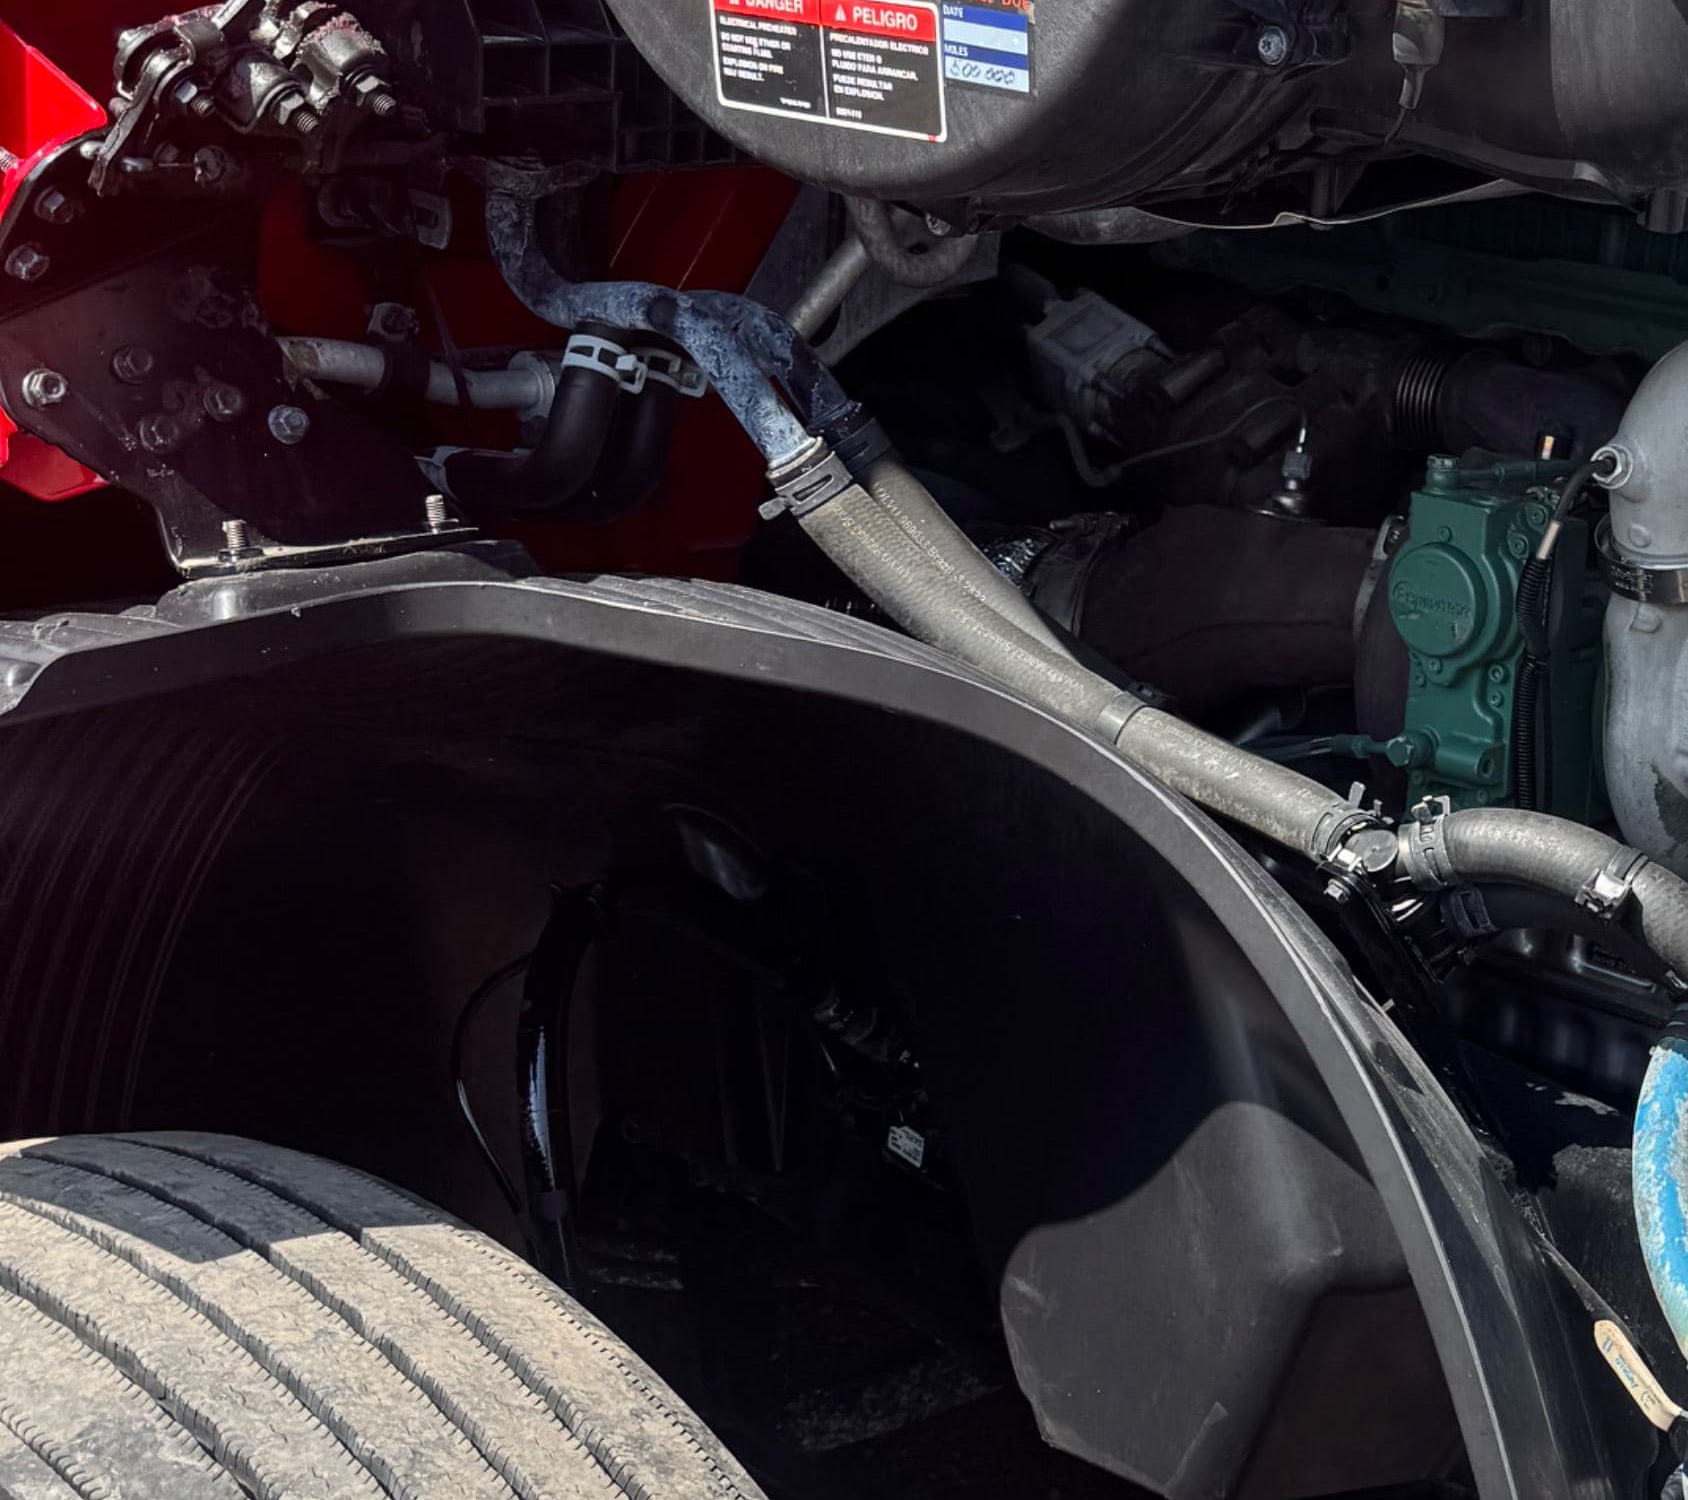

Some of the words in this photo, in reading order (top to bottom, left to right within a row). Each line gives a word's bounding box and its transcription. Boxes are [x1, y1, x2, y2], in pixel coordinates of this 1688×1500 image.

[851, 5, 918, 32] PELIGRO
[943, 4, 964, 18] DATE
[944, 42, 969, 57] MILES
